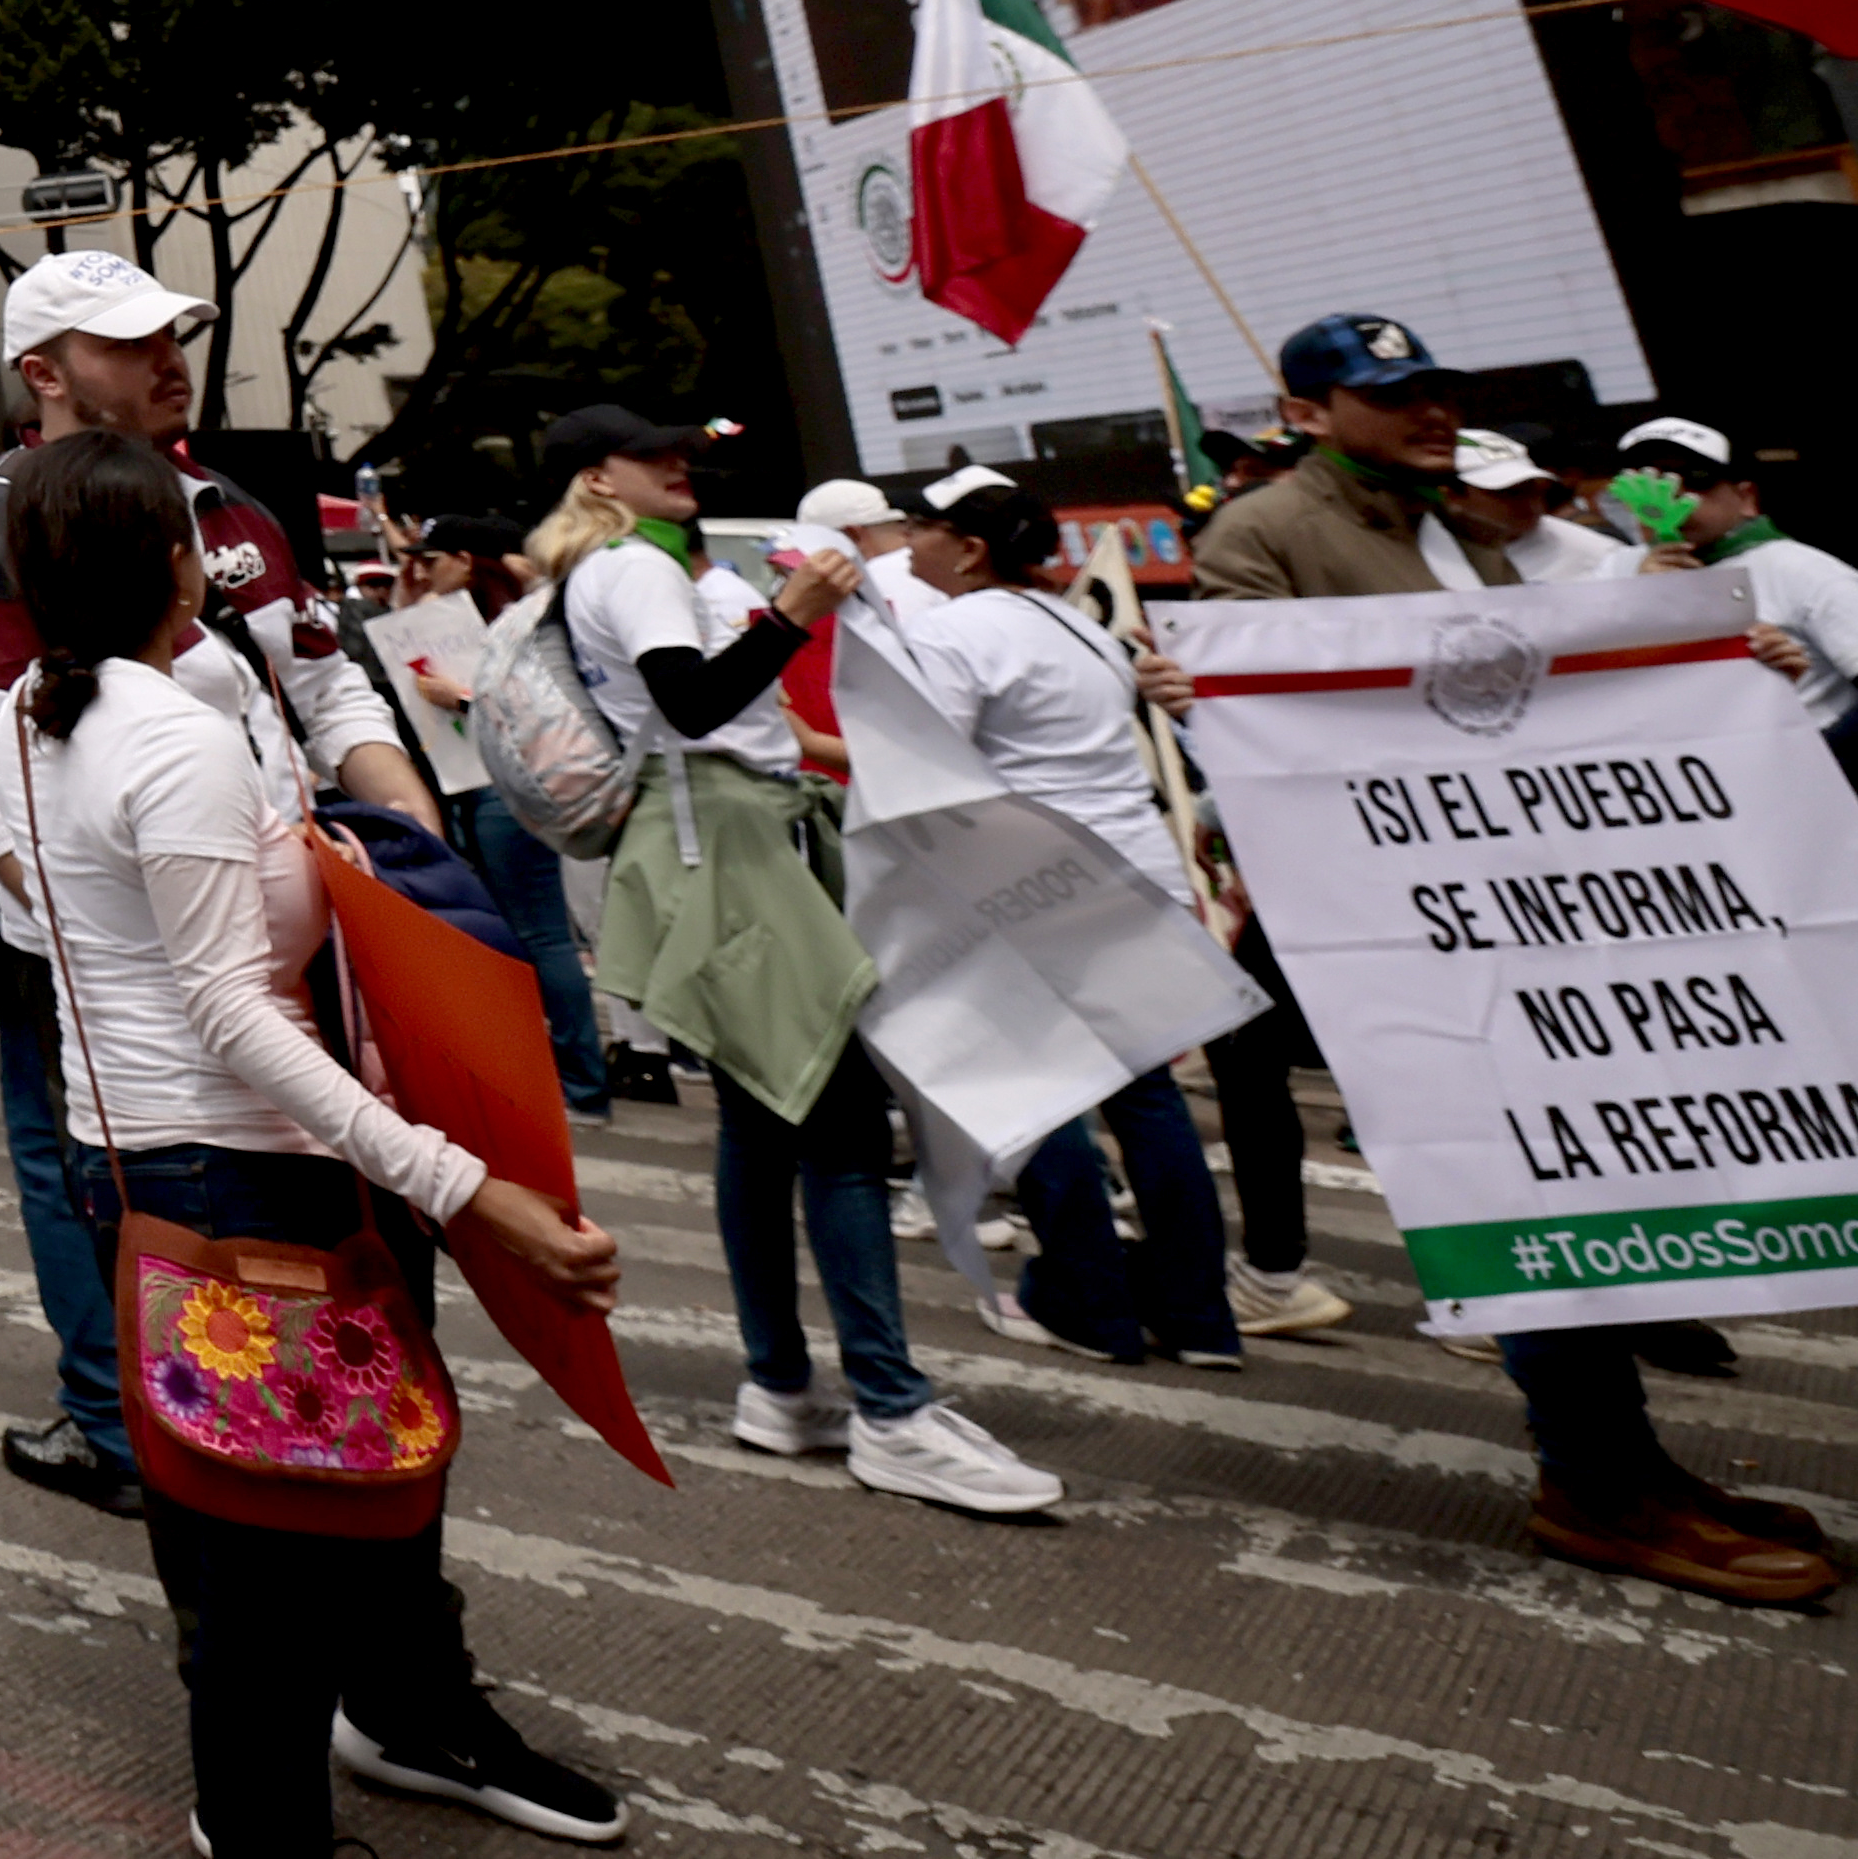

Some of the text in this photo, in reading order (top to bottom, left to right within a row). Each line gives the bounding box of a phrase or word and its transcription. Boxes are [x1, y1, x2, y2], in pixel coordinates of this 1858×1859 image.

[1426, 773, 1512, 840] EL
[1504, 755, 1734, 834] PUEBLO
[1410, 862, 1788, 953] SE INFORMA,
[1514, 974, 1786, 1060] NO PASA
[1504, 1106, 1604, 1181] LA
